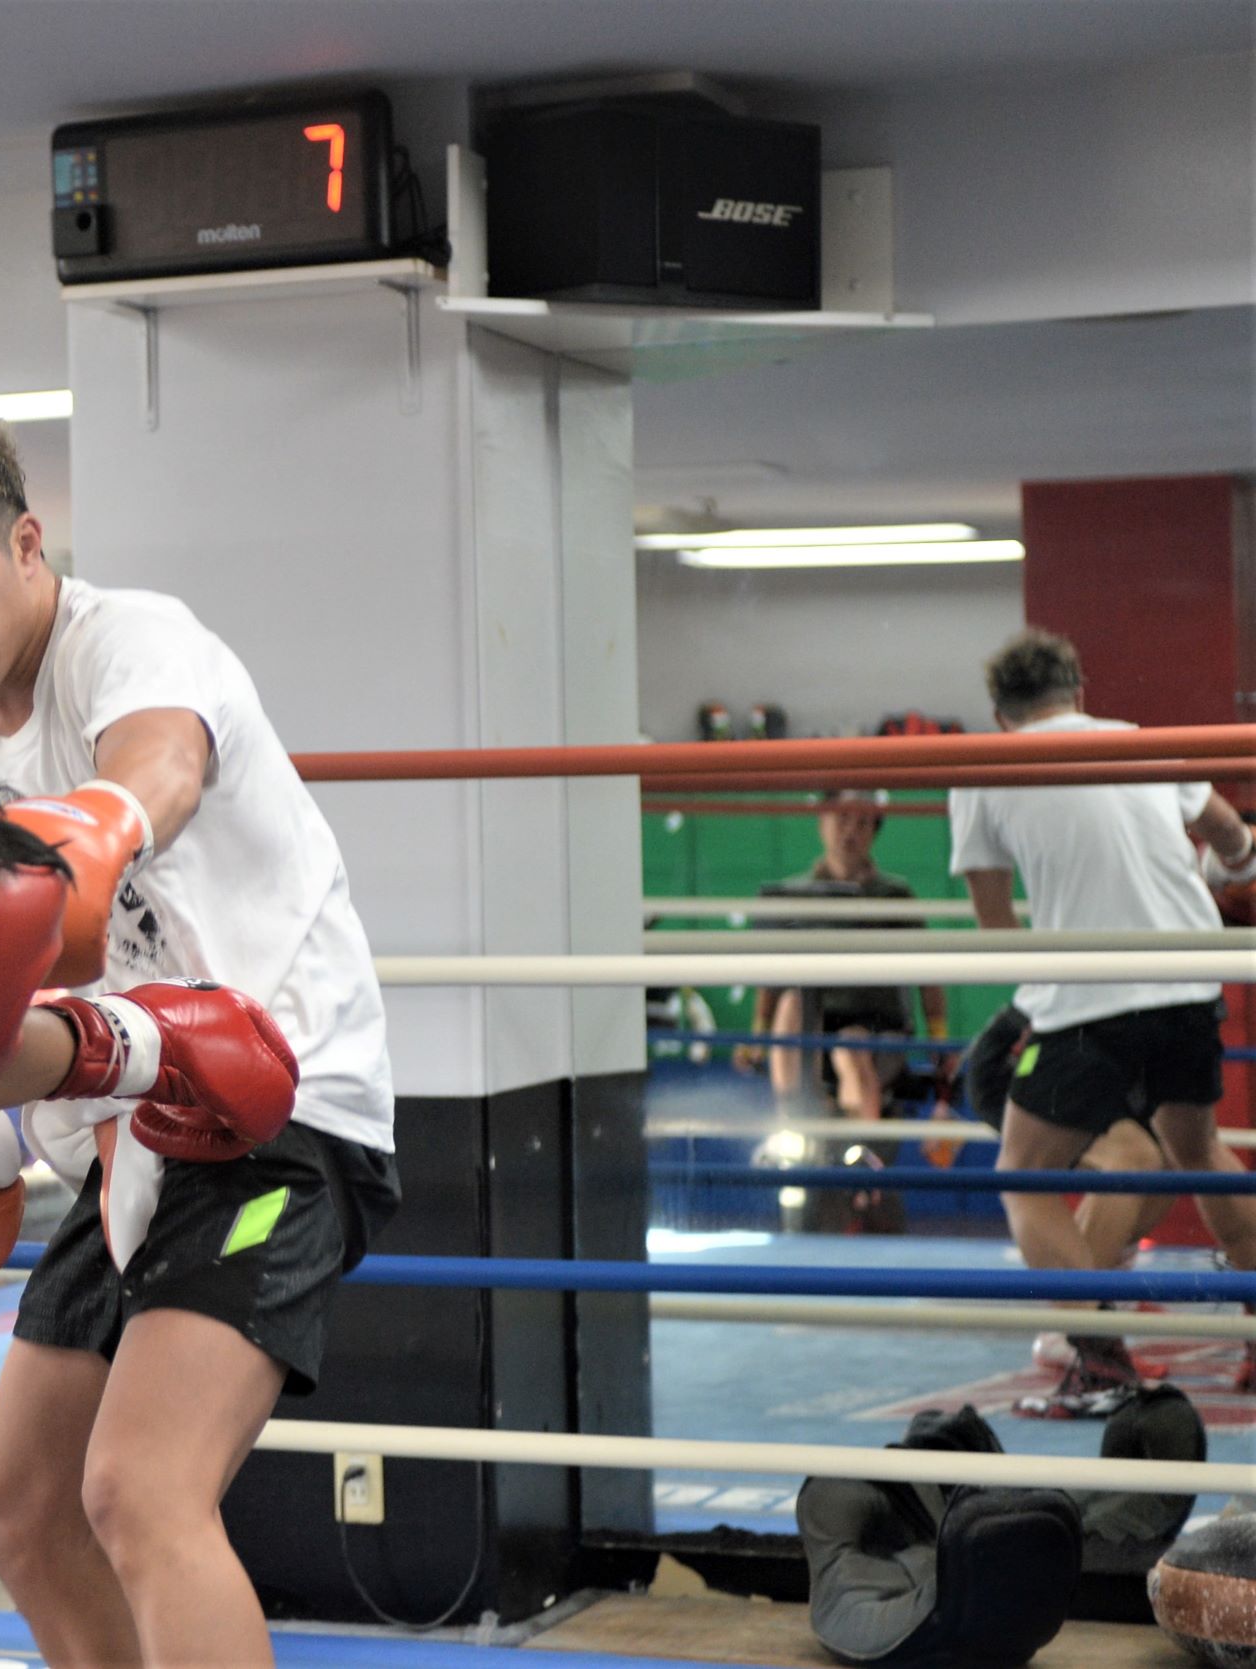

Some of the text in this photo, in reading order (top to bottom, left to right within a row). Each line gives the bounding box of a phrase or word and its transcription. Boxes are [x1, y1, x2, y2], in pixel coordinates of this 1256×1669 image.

[303, 123, 345, 213] 7
[697, 198, 803, 227] BOSE
[197, 224, 262, 244] molten
